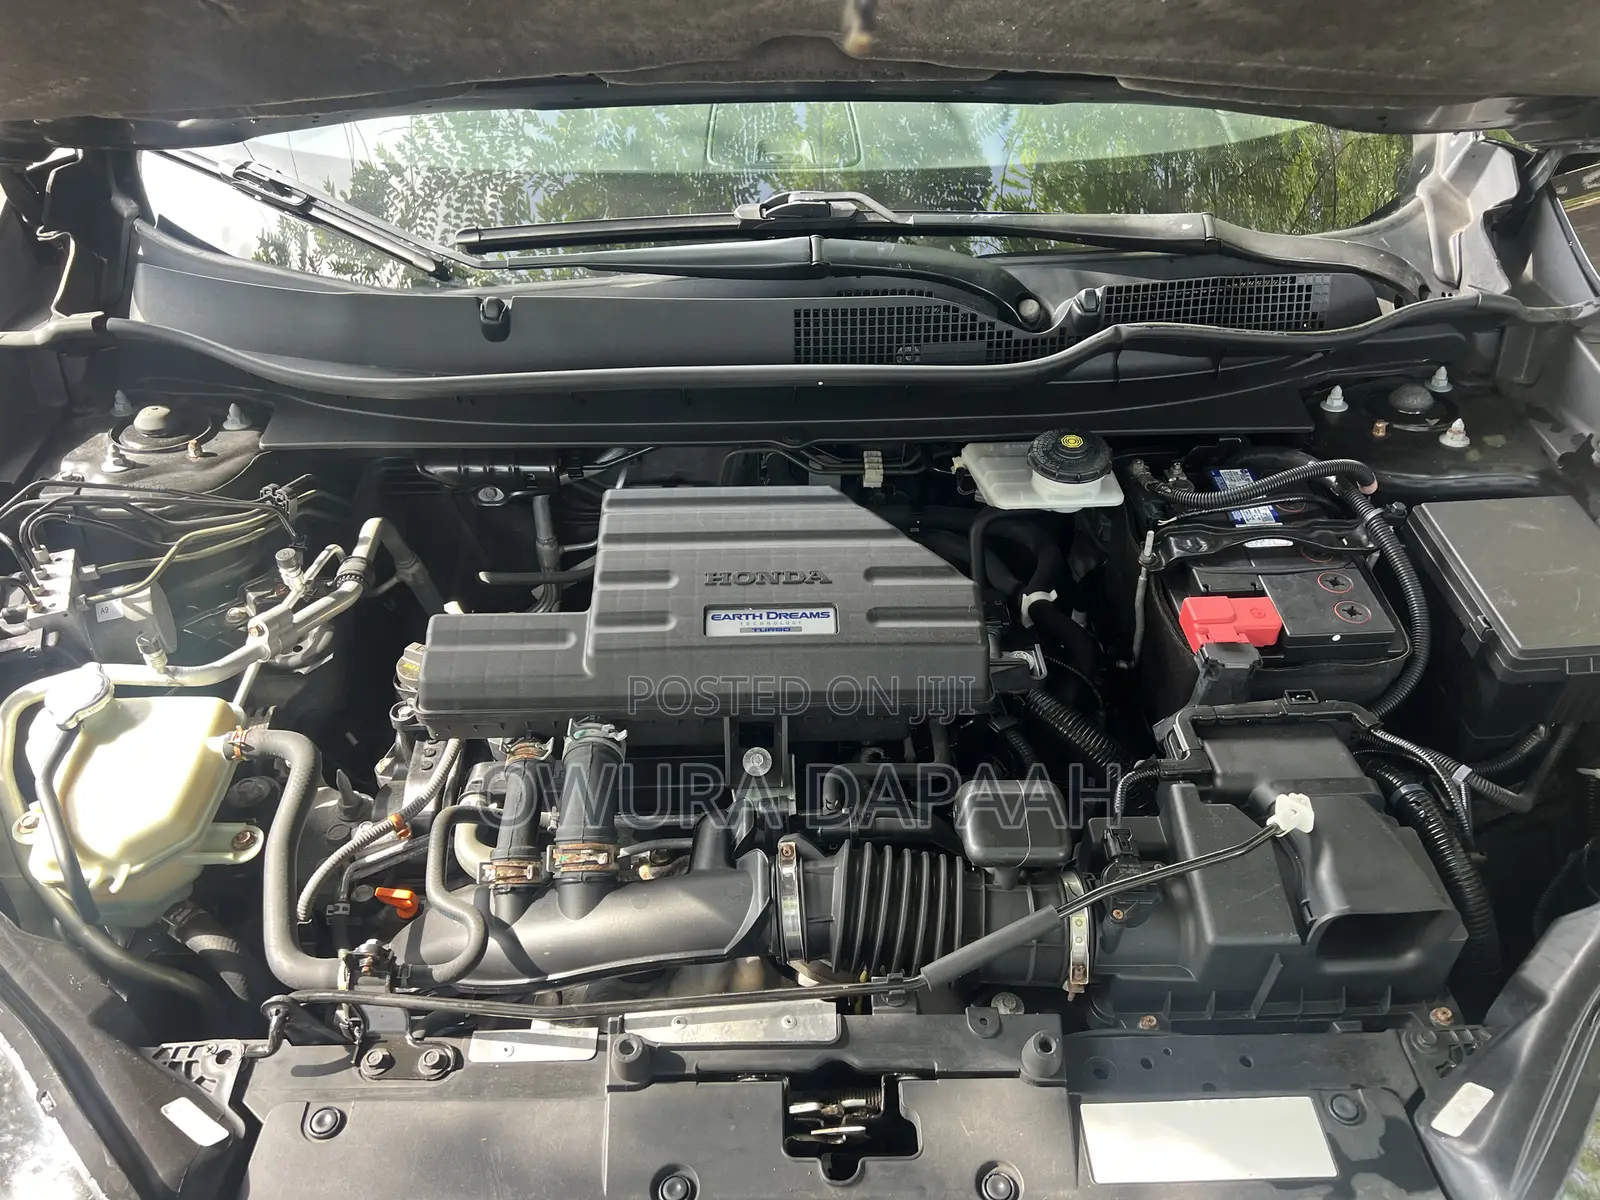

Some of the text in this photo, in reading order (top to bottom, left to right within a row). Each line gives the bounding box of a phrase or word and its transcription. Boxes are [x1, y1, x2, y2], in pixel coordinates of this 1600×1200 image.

[705, 570, 833, 586] HONDA
[100, 606, 109, 614] A9
[711, 611, 830, 621] EARTH DREAMS
